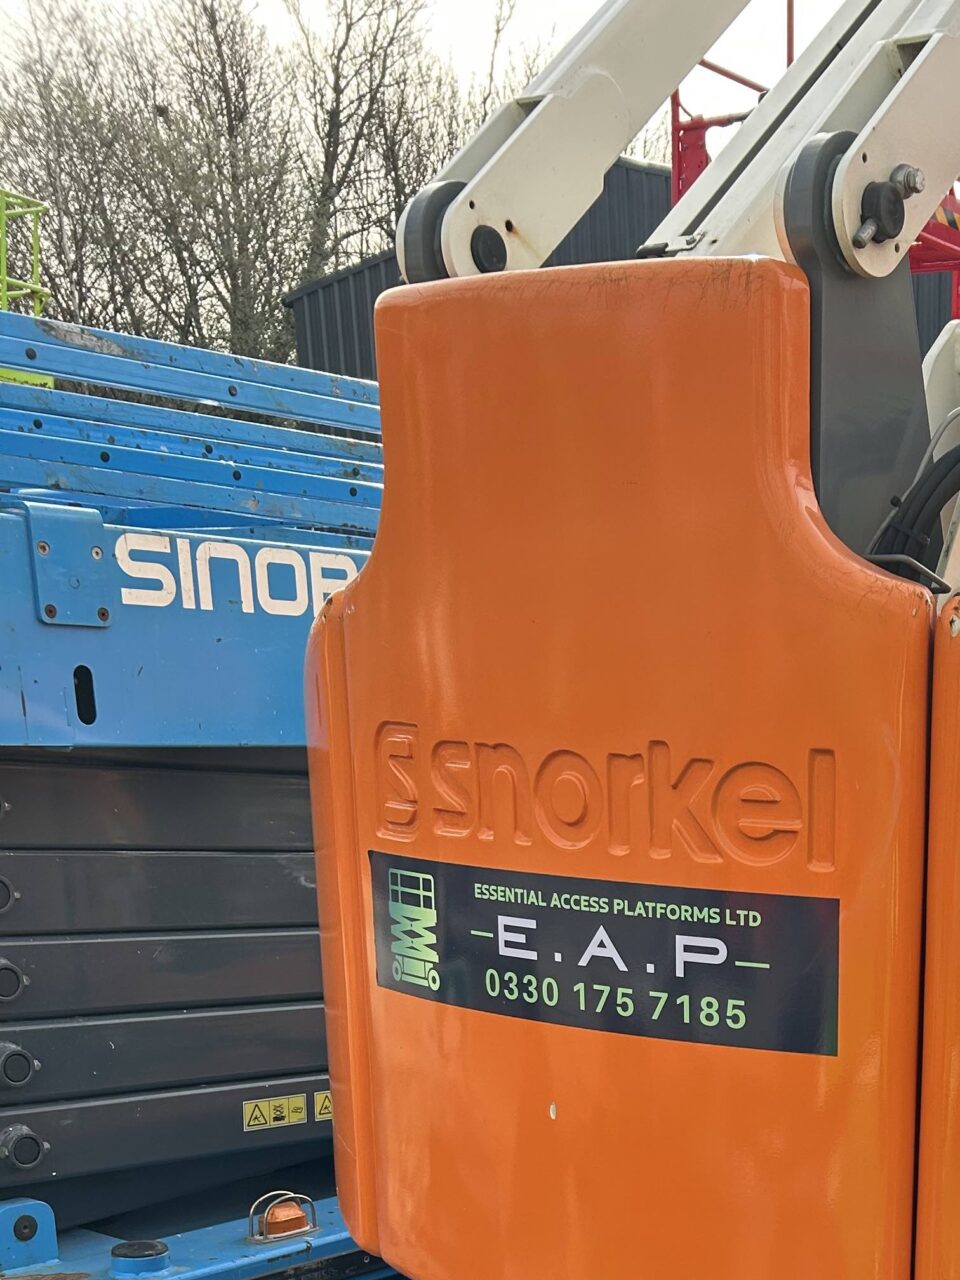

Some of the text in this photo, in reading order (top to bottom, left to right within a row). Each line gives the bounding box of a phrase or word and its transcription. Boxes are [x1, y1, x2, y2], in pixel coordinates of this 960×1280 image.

[474, 883, 762, 927] ESSENTIAL ACCESS PLATFORMS LTD
[485, 968, 746, 1029] 0330 175 7185
